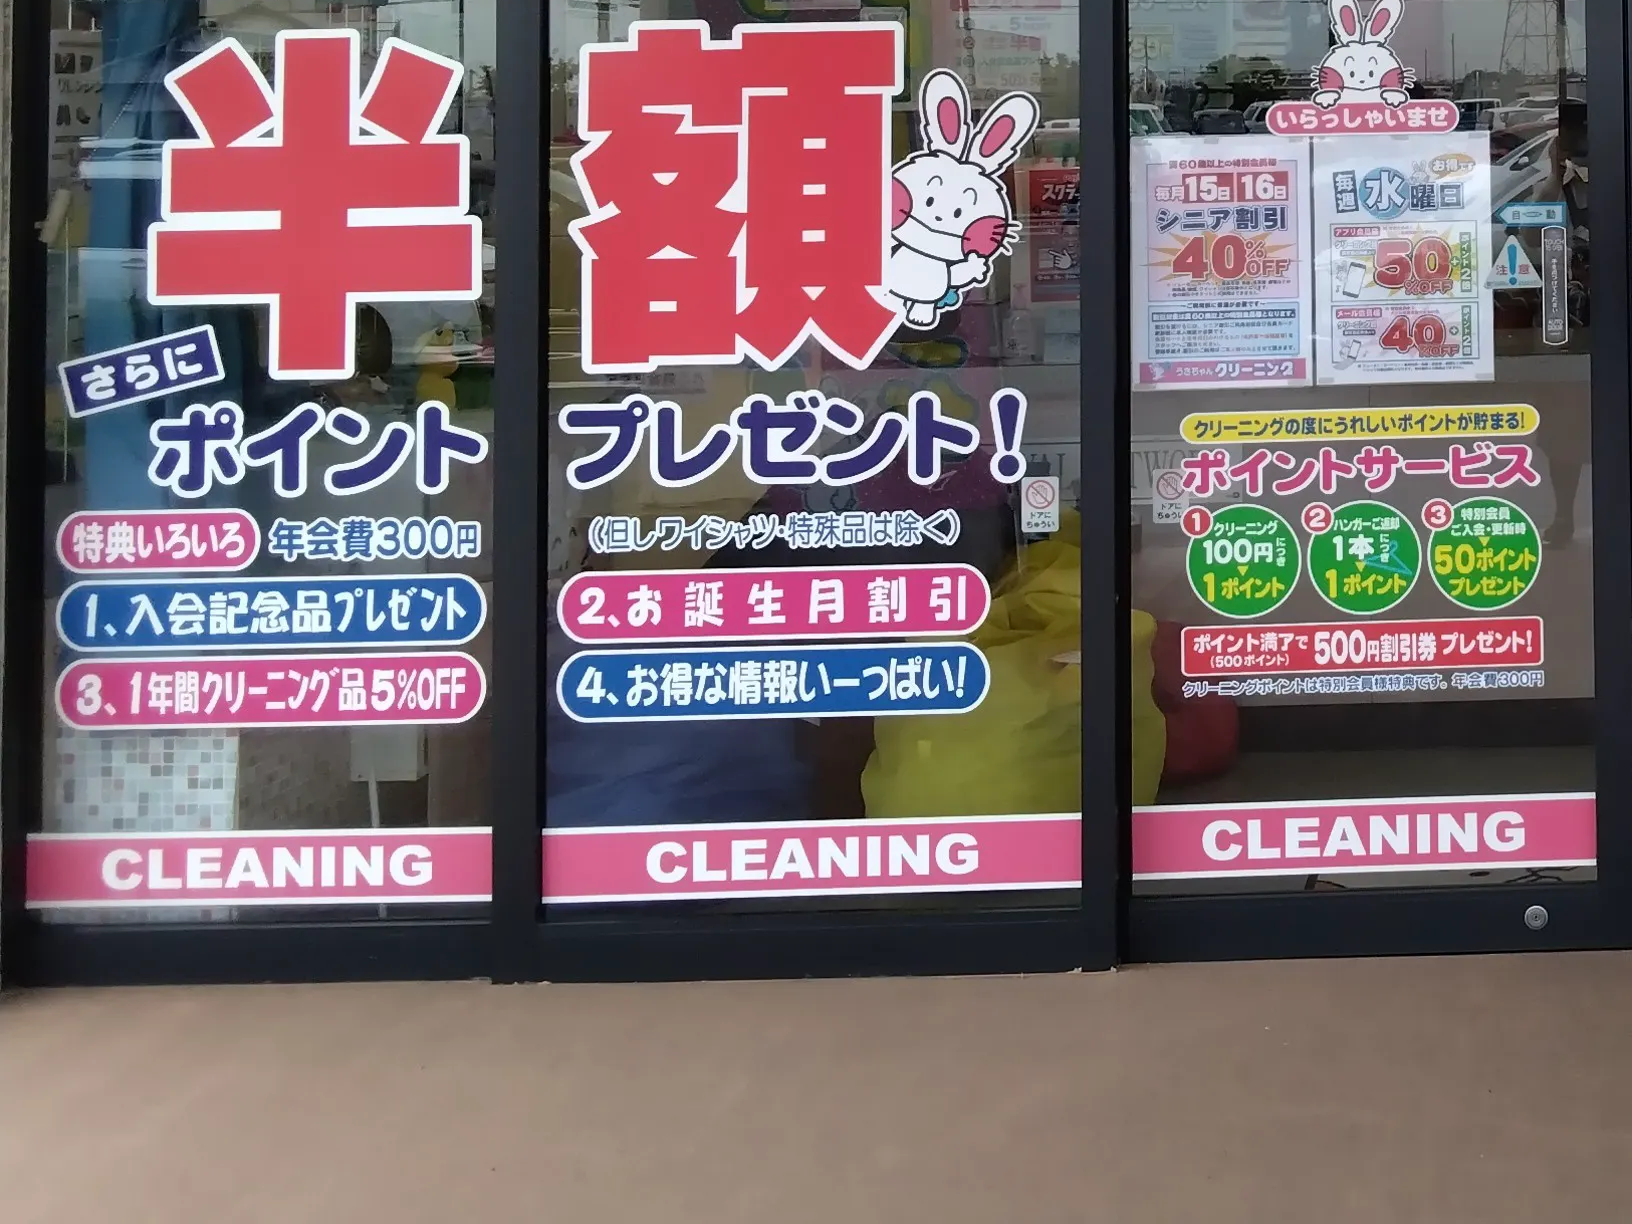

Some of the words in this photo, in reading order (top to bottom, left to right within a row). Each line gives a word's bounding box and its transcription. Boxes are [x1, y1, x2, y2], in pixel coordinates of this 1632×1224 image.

[1276, 104, 1449, 129] いらっしゃいませ
[1432, 158, 1475, 172] お得です
[147, 28, 483, 381] 半
[567, 20, 904, 374] 額
[1042, 182, 1079, 202] スクラ
[1365, 169, 1465, 211] 水曜日
[1156, 205, 1288, 232] シニア割引
[80, 340, 204, 401] さらに
[1194, 410, 1525, 438] クリーニングの度にうれしいポイントが貯まる!
[149, 400, 488, 498] ポイント
[559, 387, 1027, 490] プレゼント!
[1182, 441, 1541, 496] ポイントサービス
[1025, 519, 1057, 528] ちゅうい
[1029, 511, 1052, 519] ドアに
[1214, 520, 1278, 537] クリーニング
[1334, 517, 1400, 531] ハンガーご返却
[1451, 522, 1526, 536] ご入会・更新時
[1461, 507, 1510, 521] 特別会員
[72, 521, 246, 563] 特典いろいろ
[268, 516, 482, 562] 年会費300円
[589, 509, 960, 553] (但しワイシャツ・特殊品は除く)
[1203, 538, 1273, 565] 100円
[1276, 537, 1286, 567] につき
[1332, 533, 1374, 561] 1本
[1380, 533, 1390, 563] につき
[1435, 544, 1537, 575] 50ポイント
[1203, 572, 1285, 602] 1ポイント
[1325, 569, 1407, 598] 1ポイント
[1448, 576, 1525, 596] プレゼント
[85, 586, 468, 638] 1、入会記念品プレゼント
[576, 575, 967, 628] 2、お誕生月割引
[1193, 632, 1309, 654] ポイント満了で
[1314, 629, 1437, 665] 500円割引券
[1440, 629, 1533, 655] プレゼント!
[1210, 654, 1290, 669] (500ポイント)
[76, 666, 467, 716] 3、1年間クリーニング品5%OFF
[1182, 672, 1448, 698] クリーニングポイントは特別会員様特典です。
[1451, 670, 1545, 690] 年会費300円
[1201, 810, 1526, 861] CLEANING
[102, 844, 434, 890] CLEANING
[646, 833, 979, 884] CLEANING
